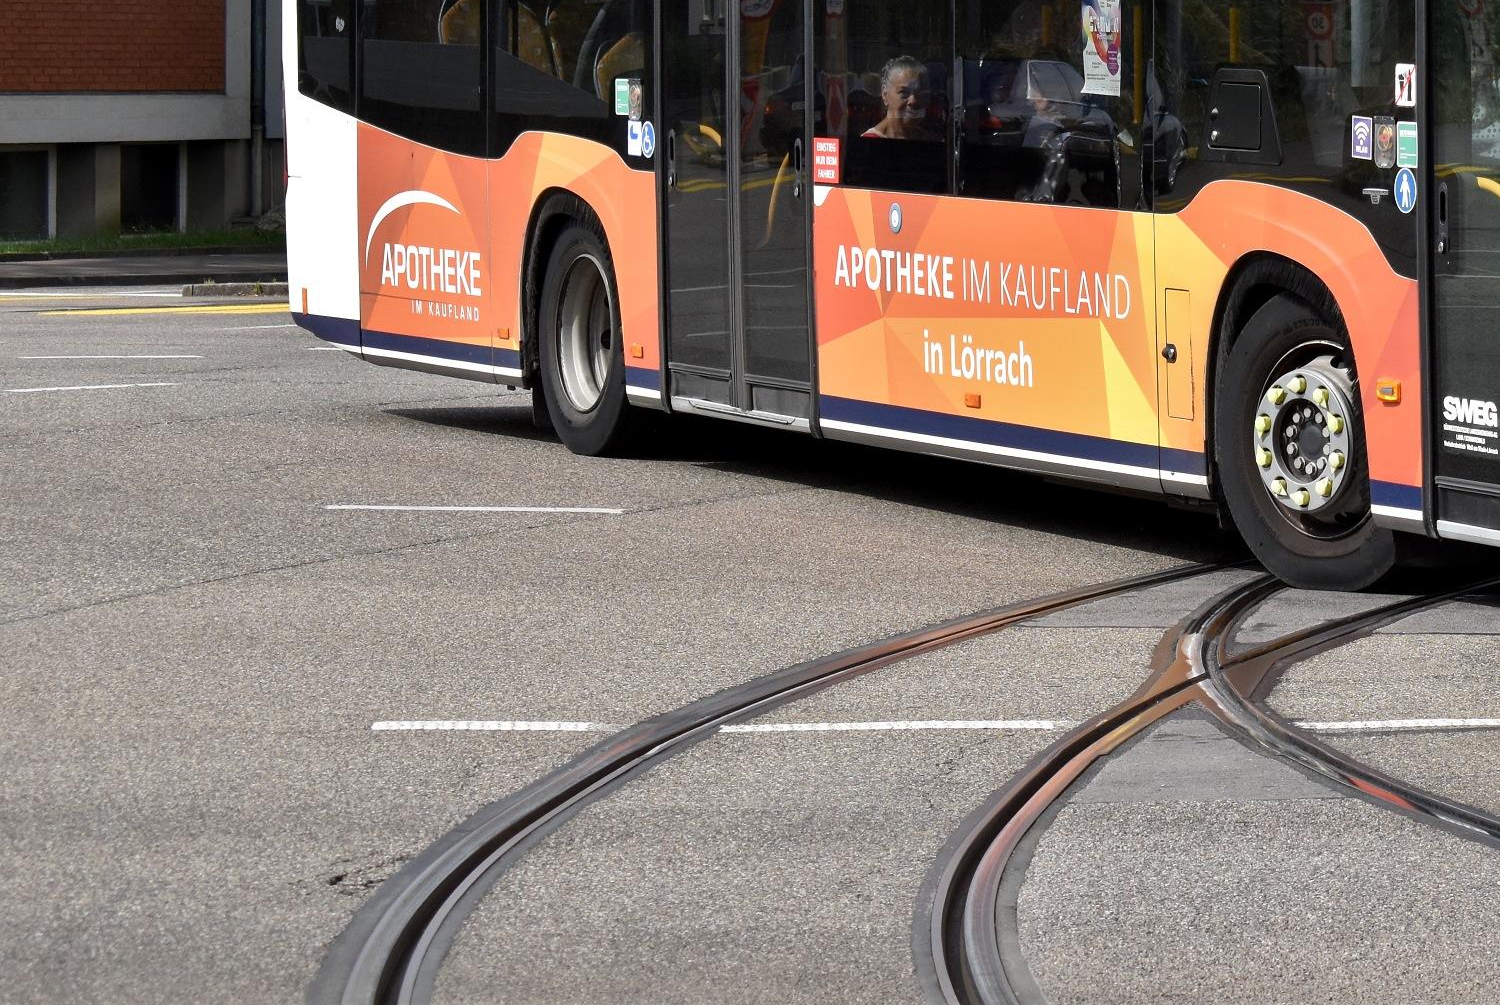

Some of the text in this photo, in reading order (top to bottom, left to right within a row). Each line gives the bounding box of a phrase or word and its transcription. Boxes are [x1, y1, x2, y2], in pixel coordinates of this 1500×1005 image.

[381, 242, 482, 297] APOTHEKE
[835, 244, 1131, 320] APOTHEKE IM KAUFLAND
[411, 299, 480, 322] IM KAUFLAND
[923, 328, 1034, 388] in Lörrach
[1443, 396, 1498, 428] SWEG
